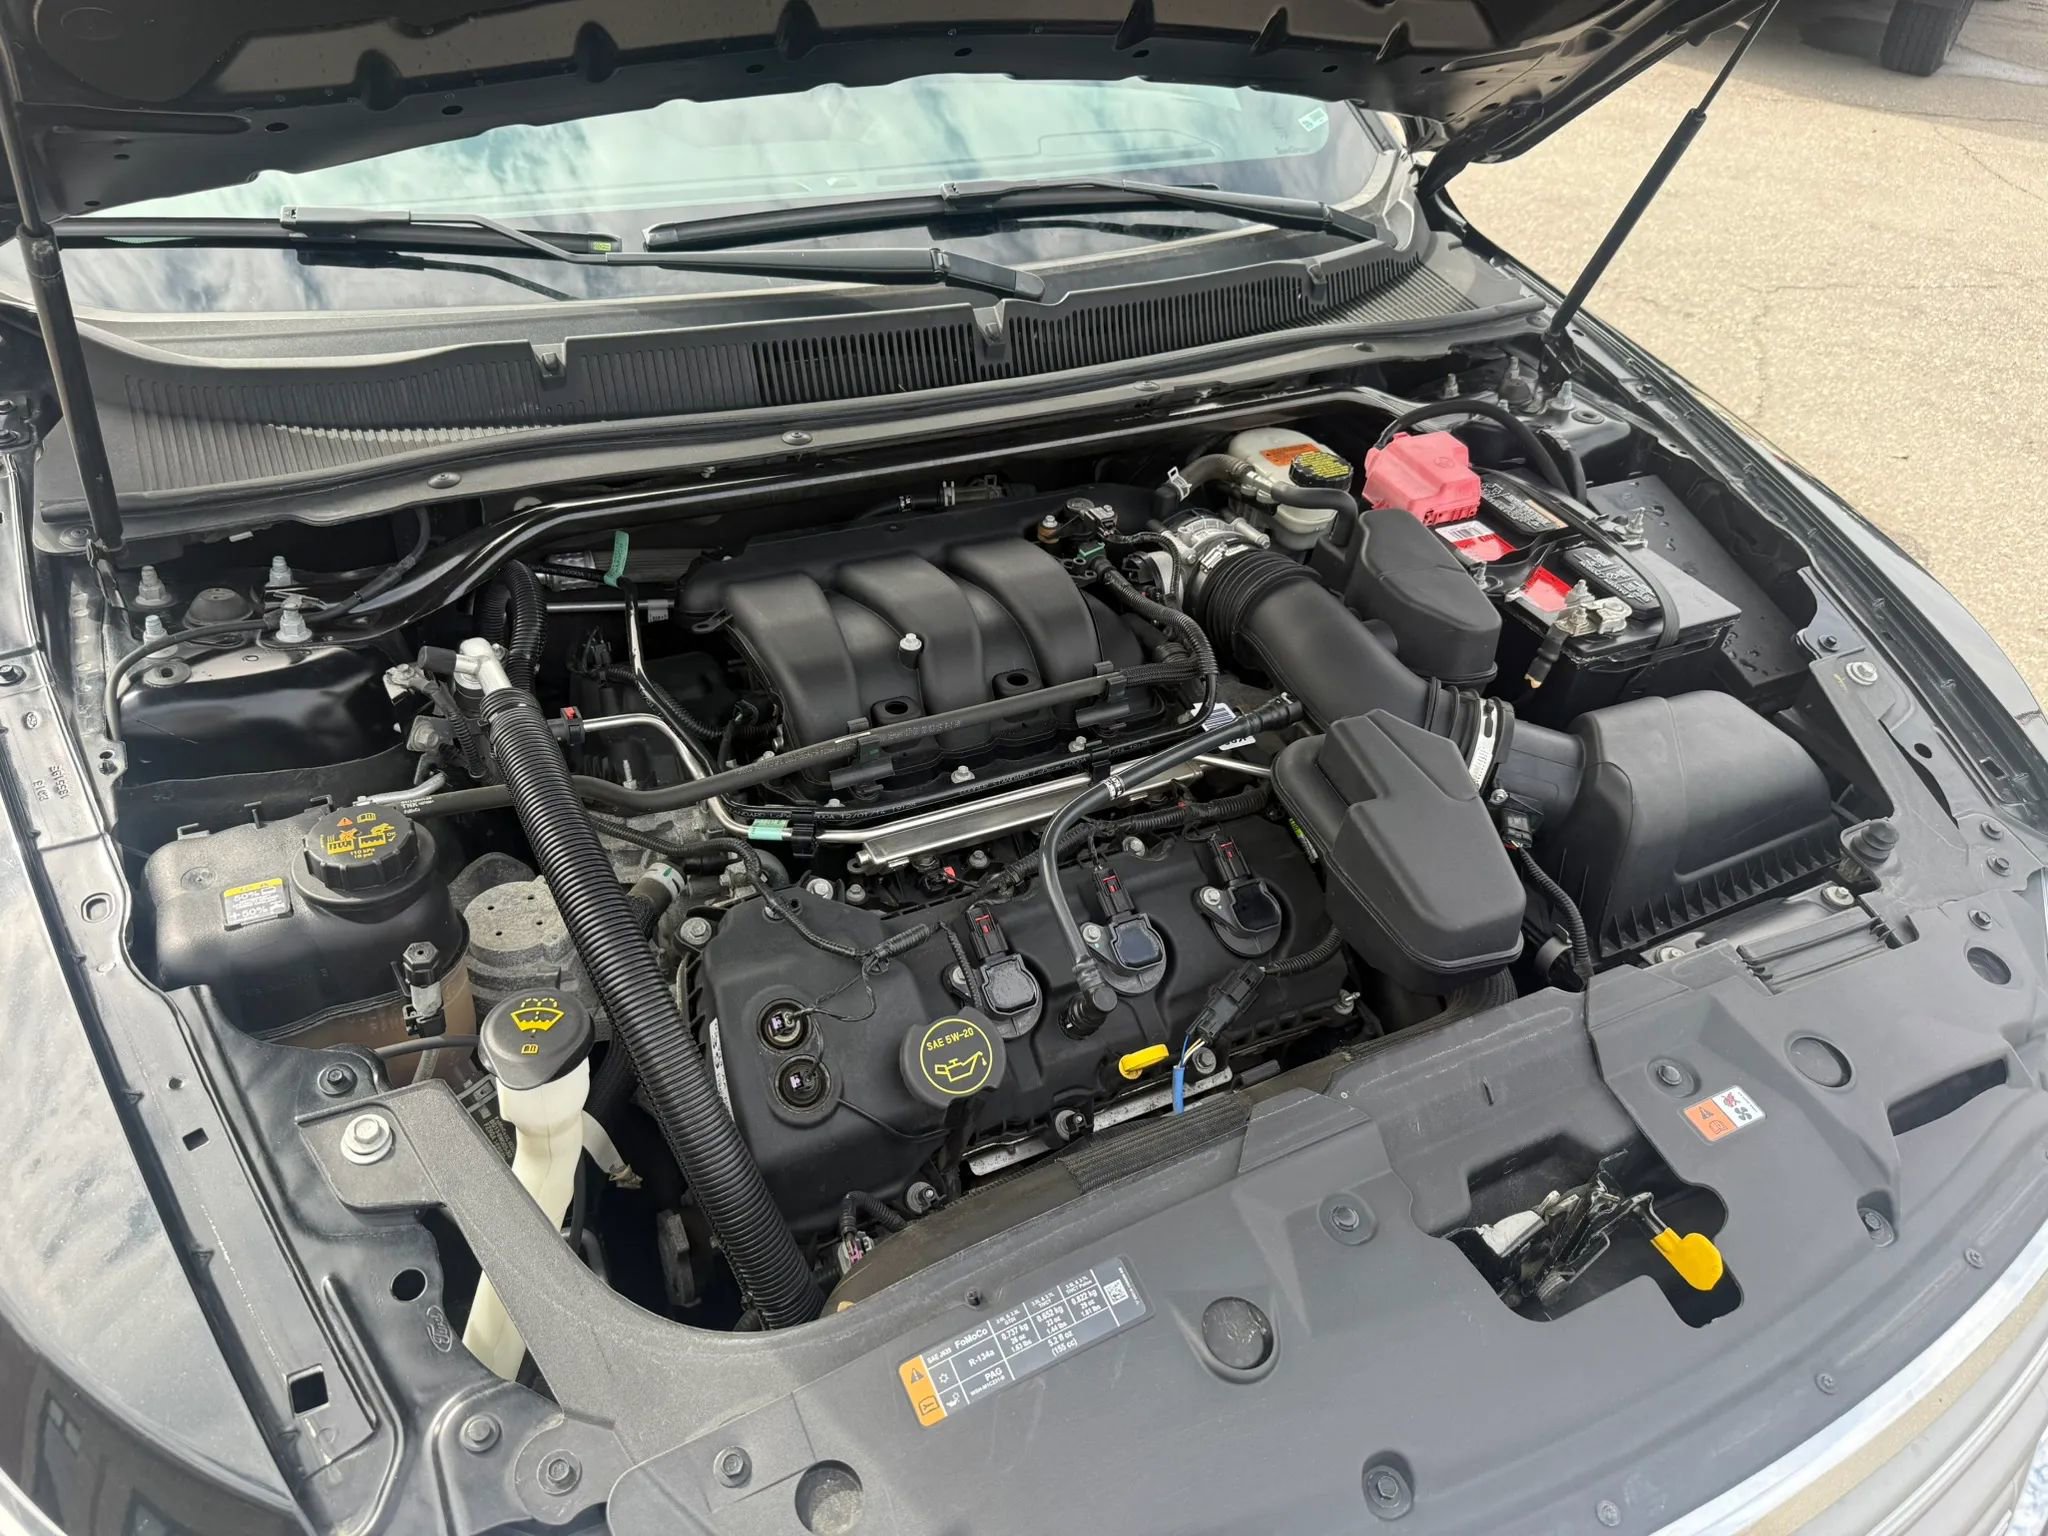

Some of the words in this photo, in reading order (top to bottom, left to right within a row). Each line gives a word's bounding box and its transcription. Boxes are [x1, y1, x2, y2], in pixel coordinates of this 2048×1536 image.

[926, 1037, 945, 1051] SAE
[945, 1027, 974, 1044] 5W-20
[1070, 1291, 1089, 1305] 0.822
[1087, 1288, 1097, 1298] kg
[1036, 1308, 1055, 1322] 0.652
[1053, 1304, 1064, 1314] kg
[1091, 1303, 1101, 1311] lbs
[1000, 1326, 1019, 1340] 0.737
[1018, 1321, 1029, 1332] kg
[1057, 1320, 1067, 1328] lbs
[954, 1328, 988, 1349] FoMoCo
[1022, 1338, 1032, 1346] lbs
[1047, 1336, 1059, 1346] 5.2
[1057, 1333, 1065, 1341] fl
[1064, 1330, 1073, 1339] oz
[1050, 1342, 1067, 1357] (155
[1065, 1337, 1078, 1349] cc)
[968, 1348, 994, 1366] R-134a
[984, 1367, 1002, 1381] PAG
